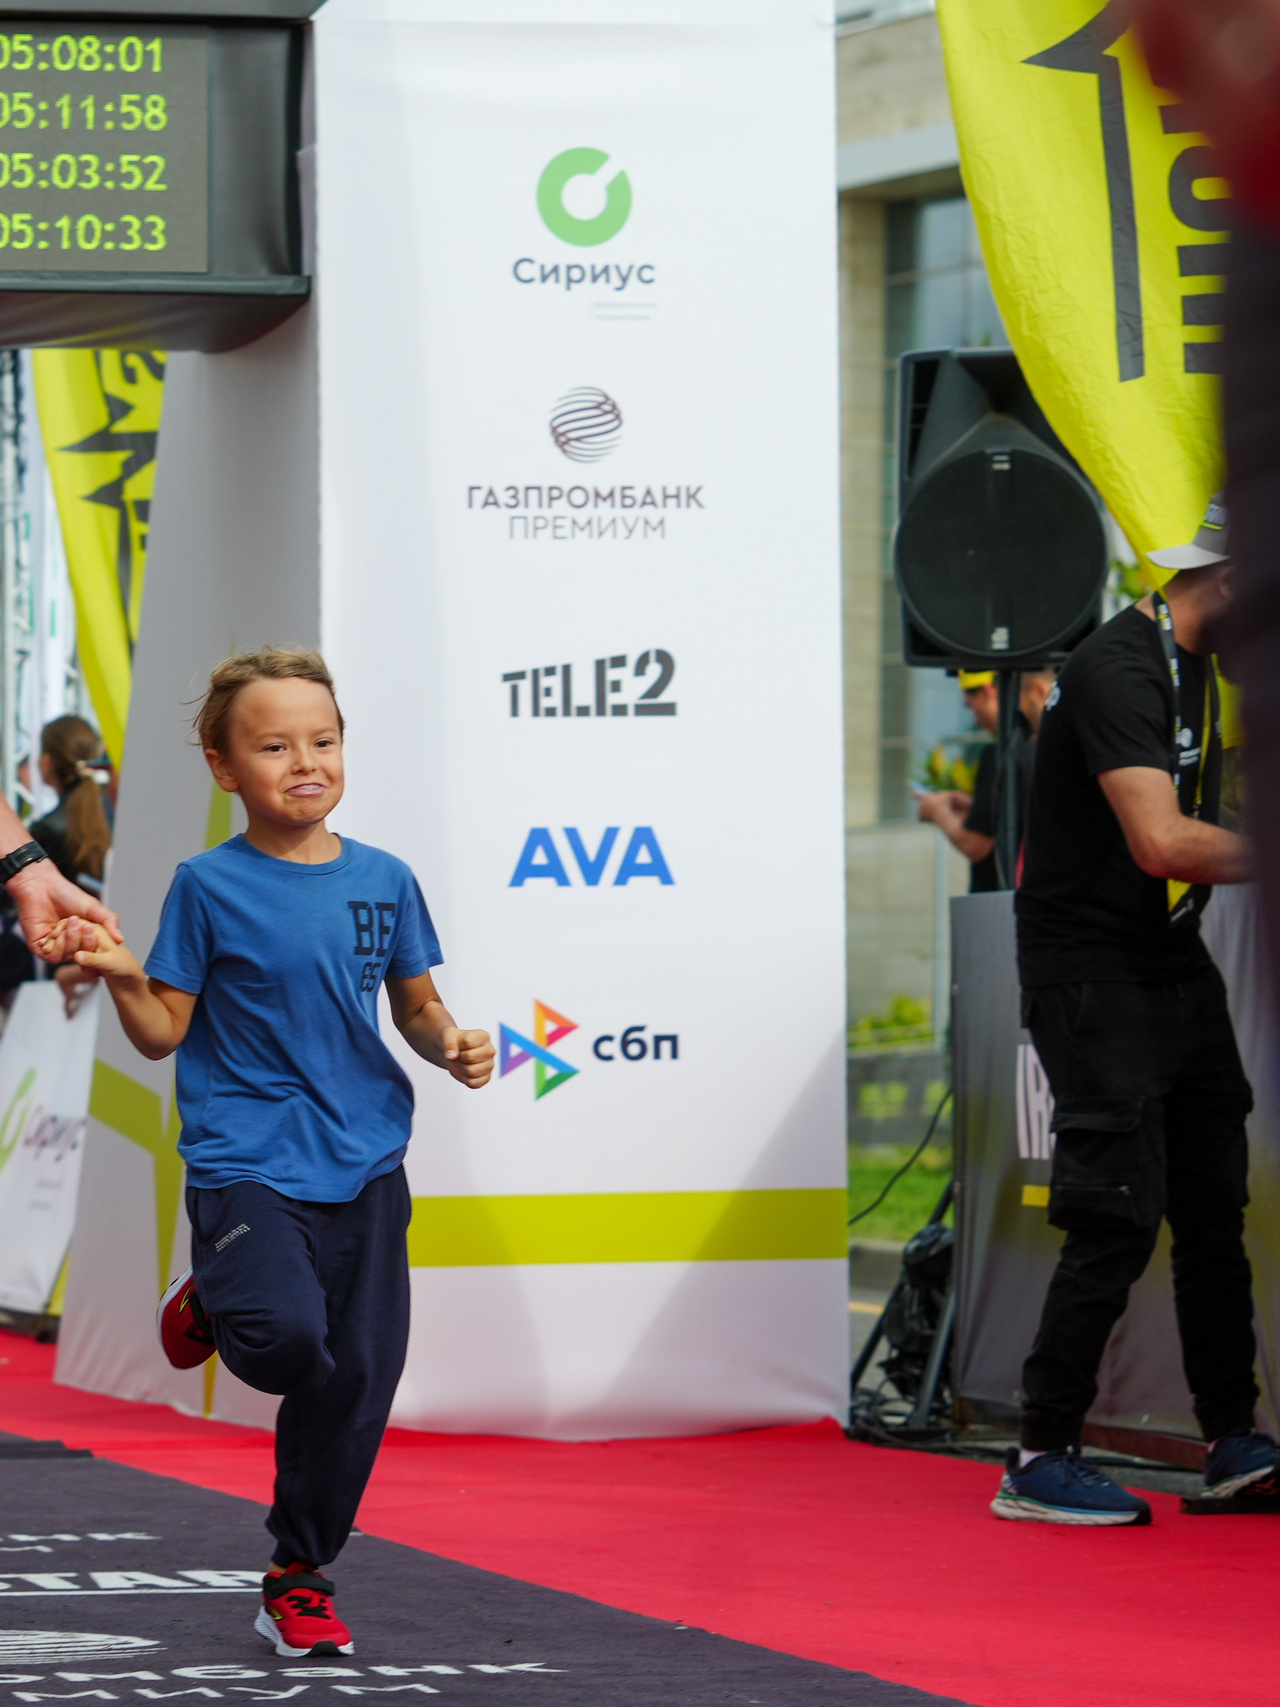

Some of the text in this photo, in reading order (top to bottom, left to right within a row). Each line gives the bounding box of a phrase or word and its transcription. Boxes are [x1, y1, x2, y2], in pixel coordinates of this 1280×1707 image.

[512, 256, 657, 291] Сириус
[467, 485, 705, 509] ГАЗПРОМБАНК
[509, 515, 666, 540] ПРЕМИУМ
[501, 648, 678, 718] TELE2
[508, 826, 676, 888] AVA
[592, 1025, 680, 1062] сбп
